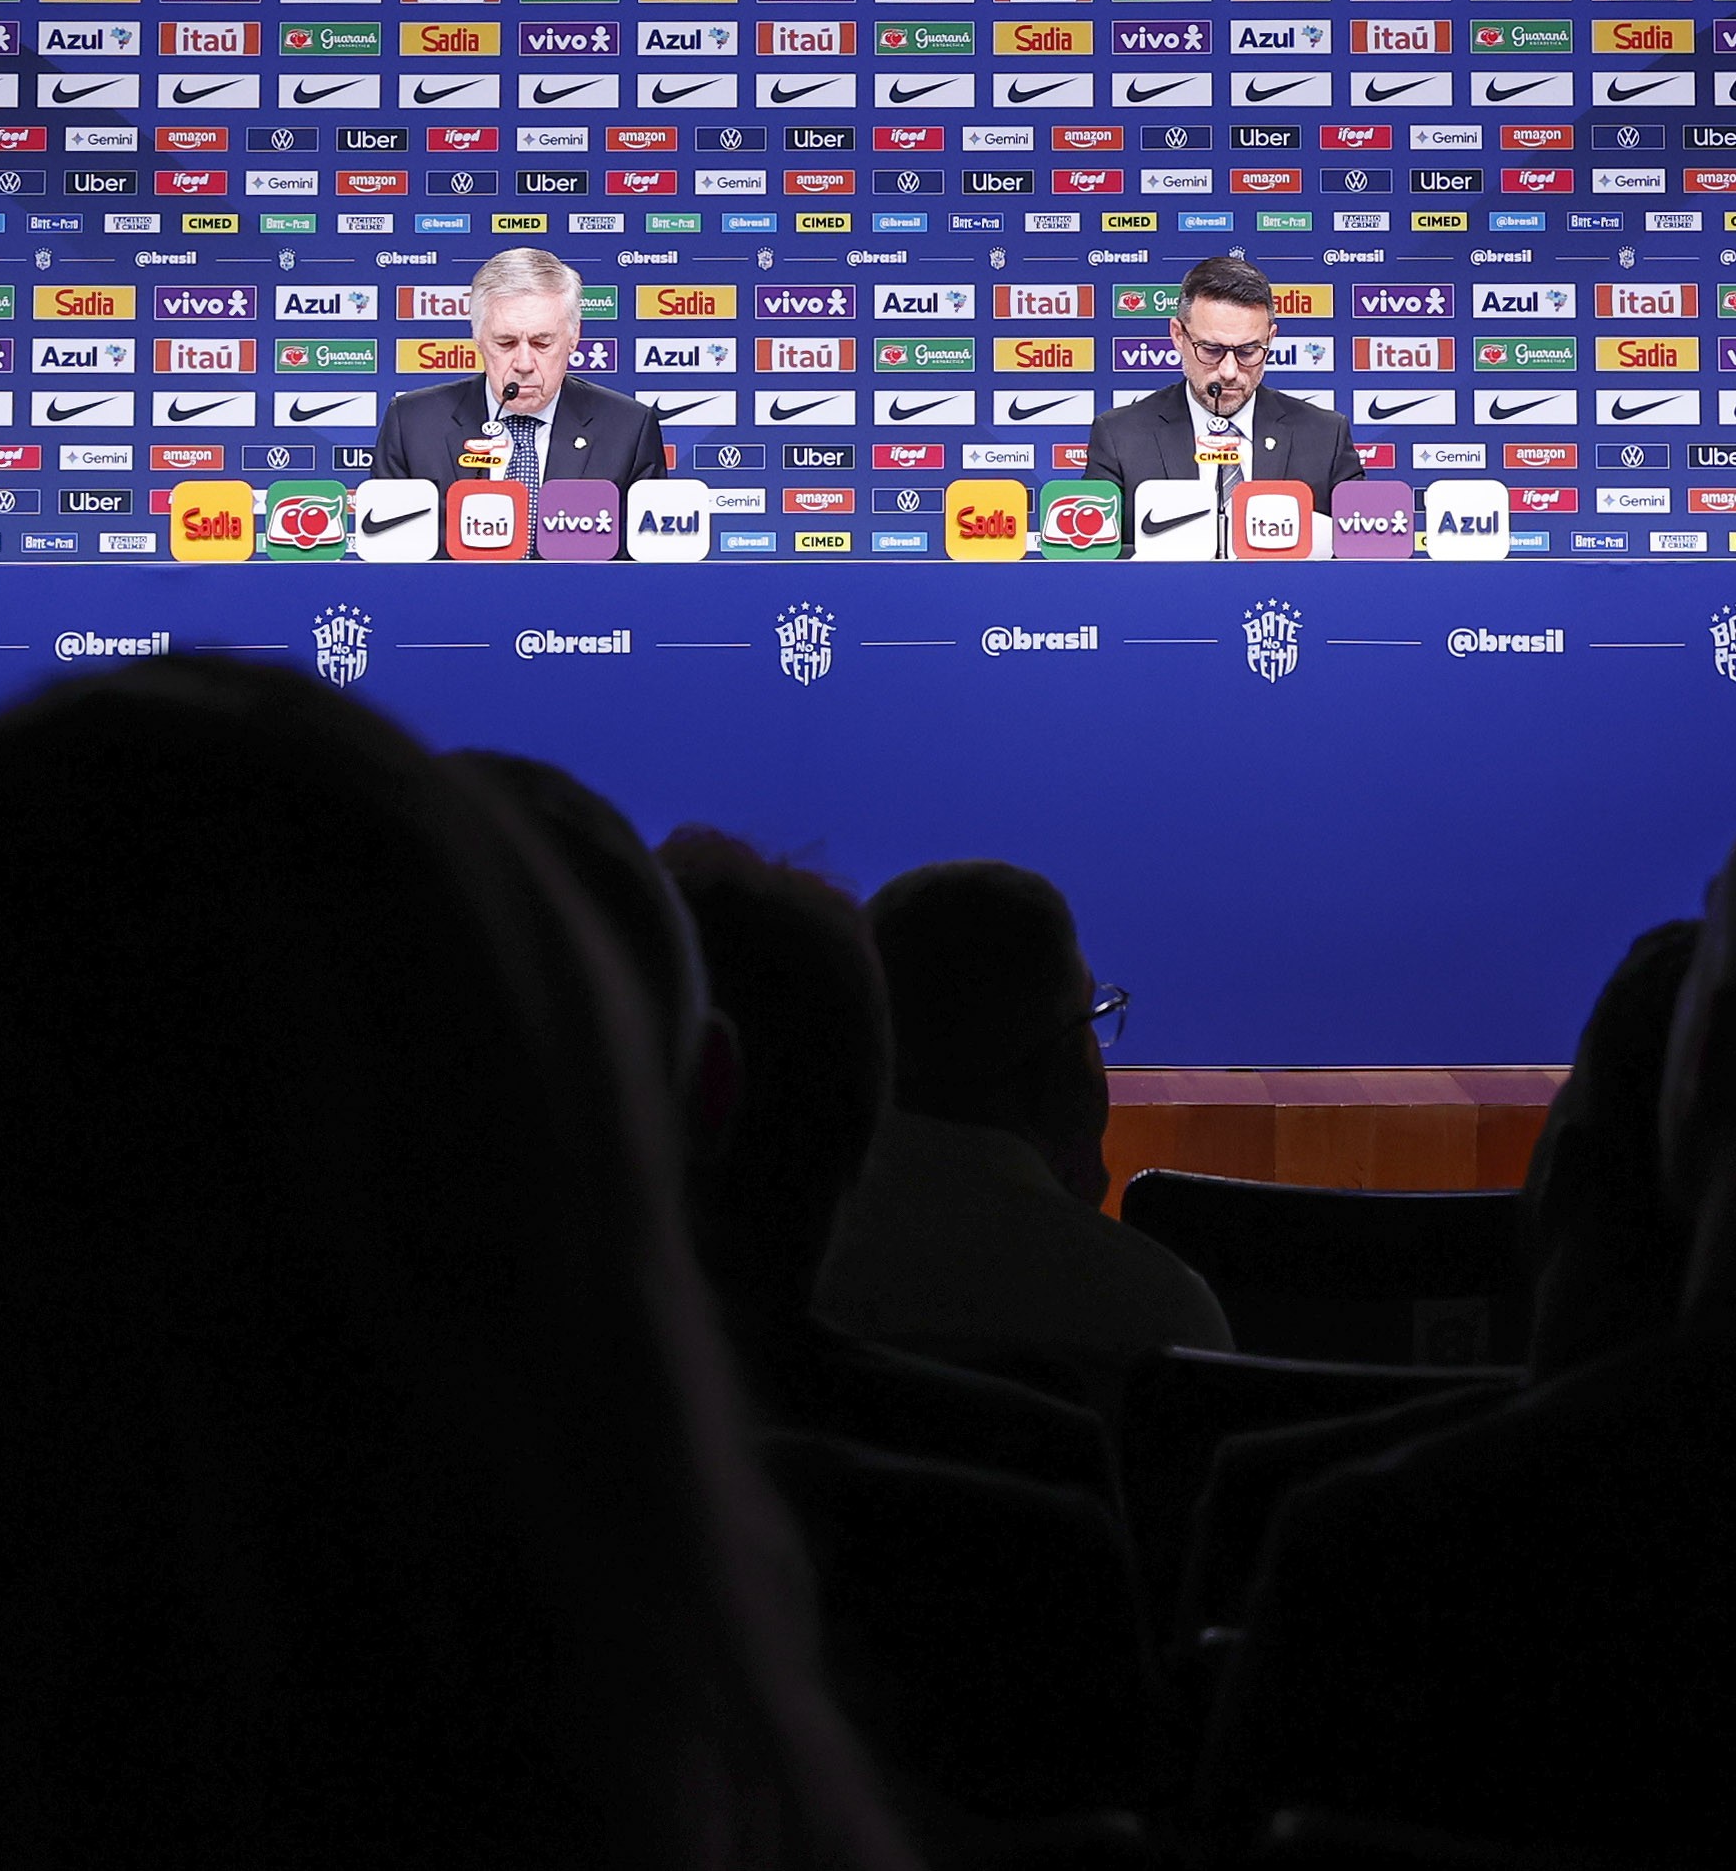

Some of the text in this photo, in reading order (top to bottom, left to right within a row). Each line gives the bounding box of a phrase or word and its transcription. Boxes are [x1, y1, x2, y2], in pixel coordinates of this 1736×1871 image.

[88, 134, 132, 145] Gemini
[169, 132, 216, 143] amazon
[347, 131, 397, 148] Uber
[539, 134, 583, 145] Gemini
[619, 132, 665, 142] amazon
[795, 130, 844, 147] Uber
[985, 133, 1028, 144] Gemini
[1065, 131, 1111, 142] amazon
[1240, 129, 1290, 146] Uber
[1433, 132, 1477, 143] Gemini
[1514, 130, 1561, 141] amazon
[189, 219, 231, 228] CIMED
[135, 252, 196, 267] @brasil
[376, 252, 436, 267] @brasil
[1199, 453, 1239, 461] CIMED
[182, 508, 241, 541] Sadia
[467, 516, 507, 535] itaú
[543, 510, 593, 530] vivo
[638, 511, 699, 534] Azul
[957, 506, 1016, 539] Sadia
[1250, 515, 1294, 538] itaú
[1339, 512, 1388, 531] vivo
[1438, 511, 1498, 535] Azul
[312, 616, 373, 649] BATE
[776, 615, 836, 647] BATE
[1242, 611, 1303, 644] BATE
[55, 632, 170, 661] @brasil
[332, 643, 351, 654] NO
[516, 630, 630, 659] @brasil
[796, 641, 814, 652] NO
[982, 626, 1097, 656] @brasil
[1262, 638, 1281, 649] NO
[1448, 628, 1563, 657] @brasil
